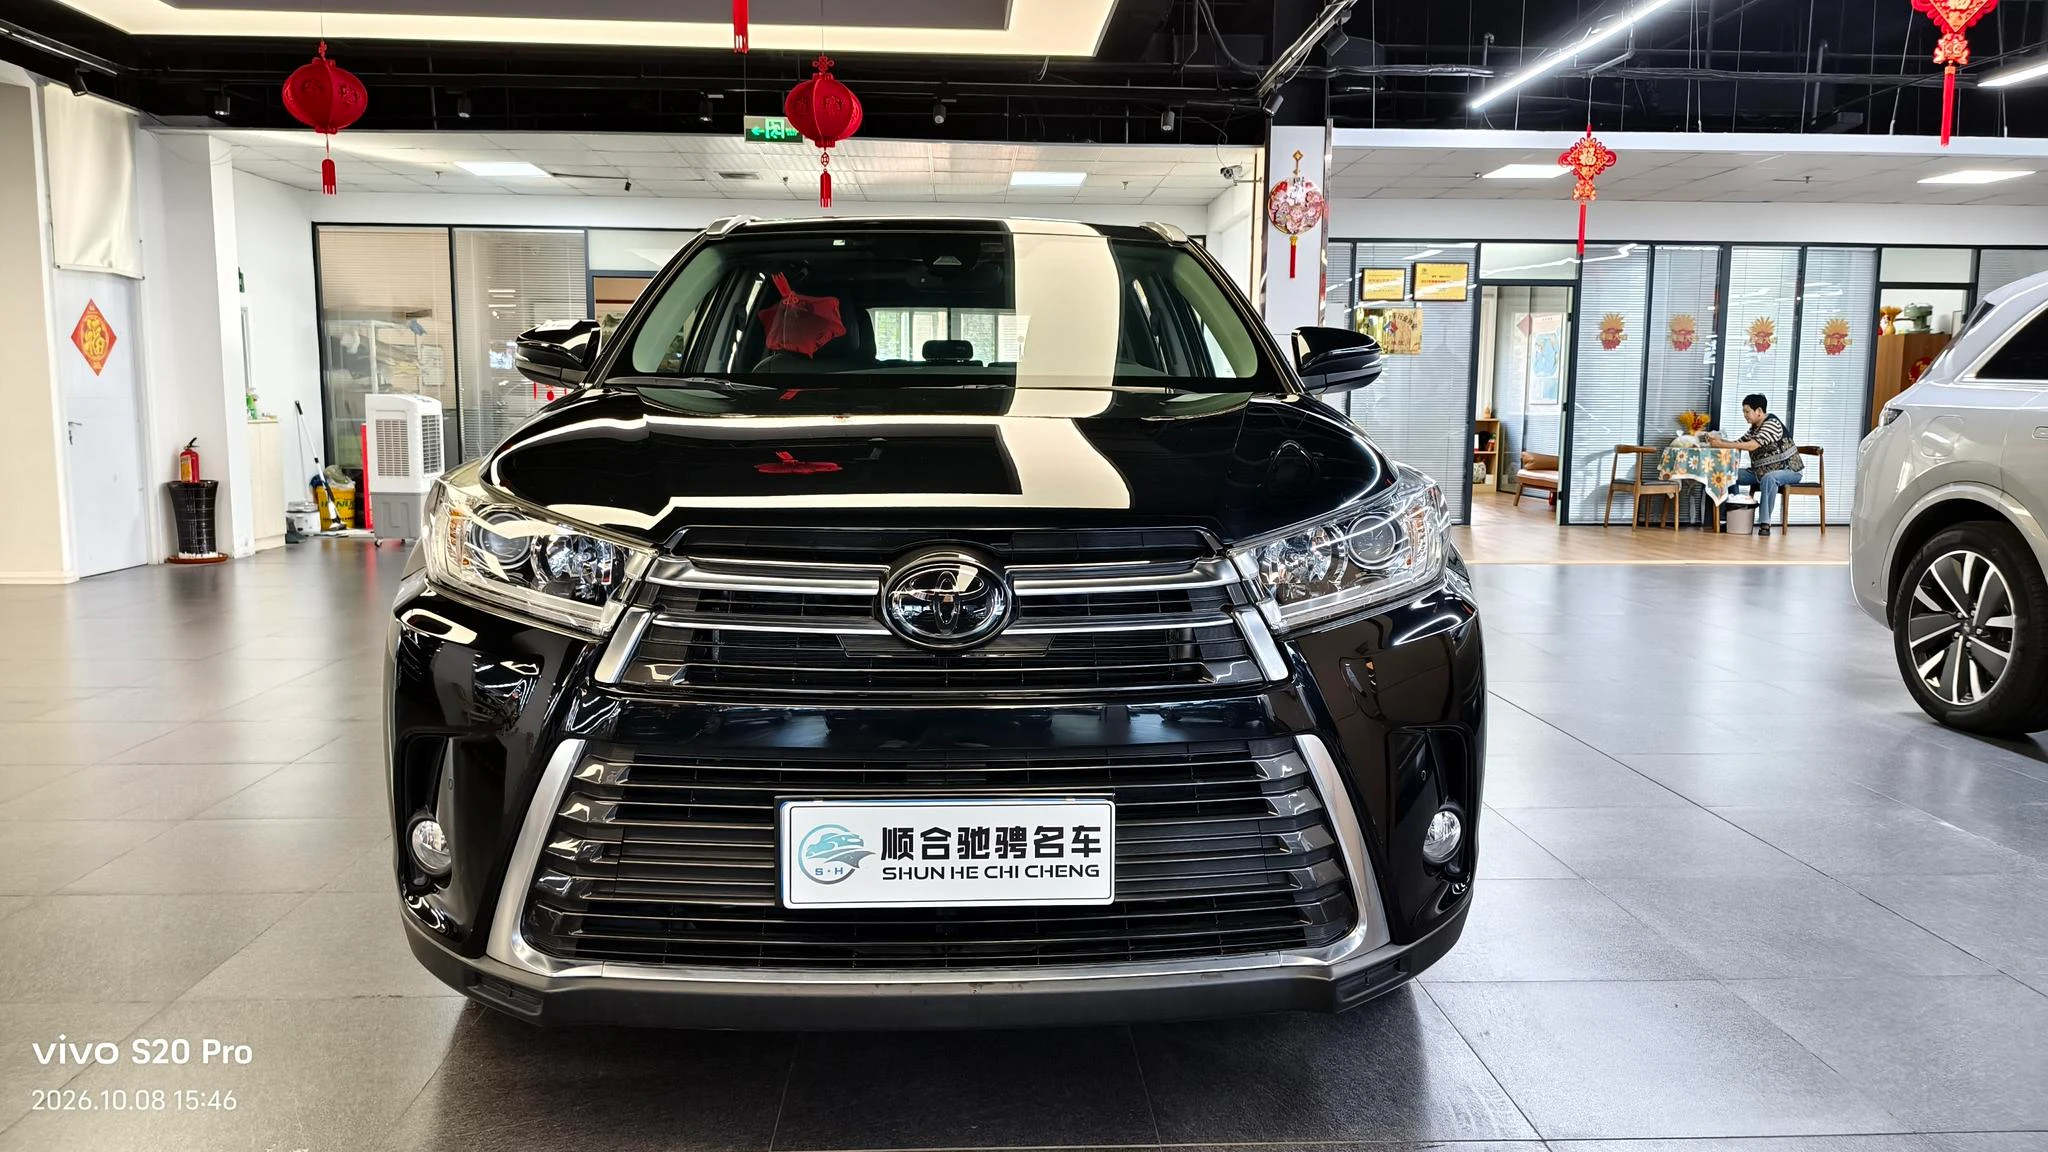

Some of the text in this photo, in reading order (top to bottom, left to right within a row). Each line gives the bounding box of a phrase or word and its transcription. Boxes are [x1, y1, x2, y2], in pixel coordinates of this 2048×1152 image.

[83, 317, 106, 357] 福
[881, 826, 1101, 861] 顺合驰骋名车
[882, 864, 1100, 881] SHUN HE CHI CHENG
